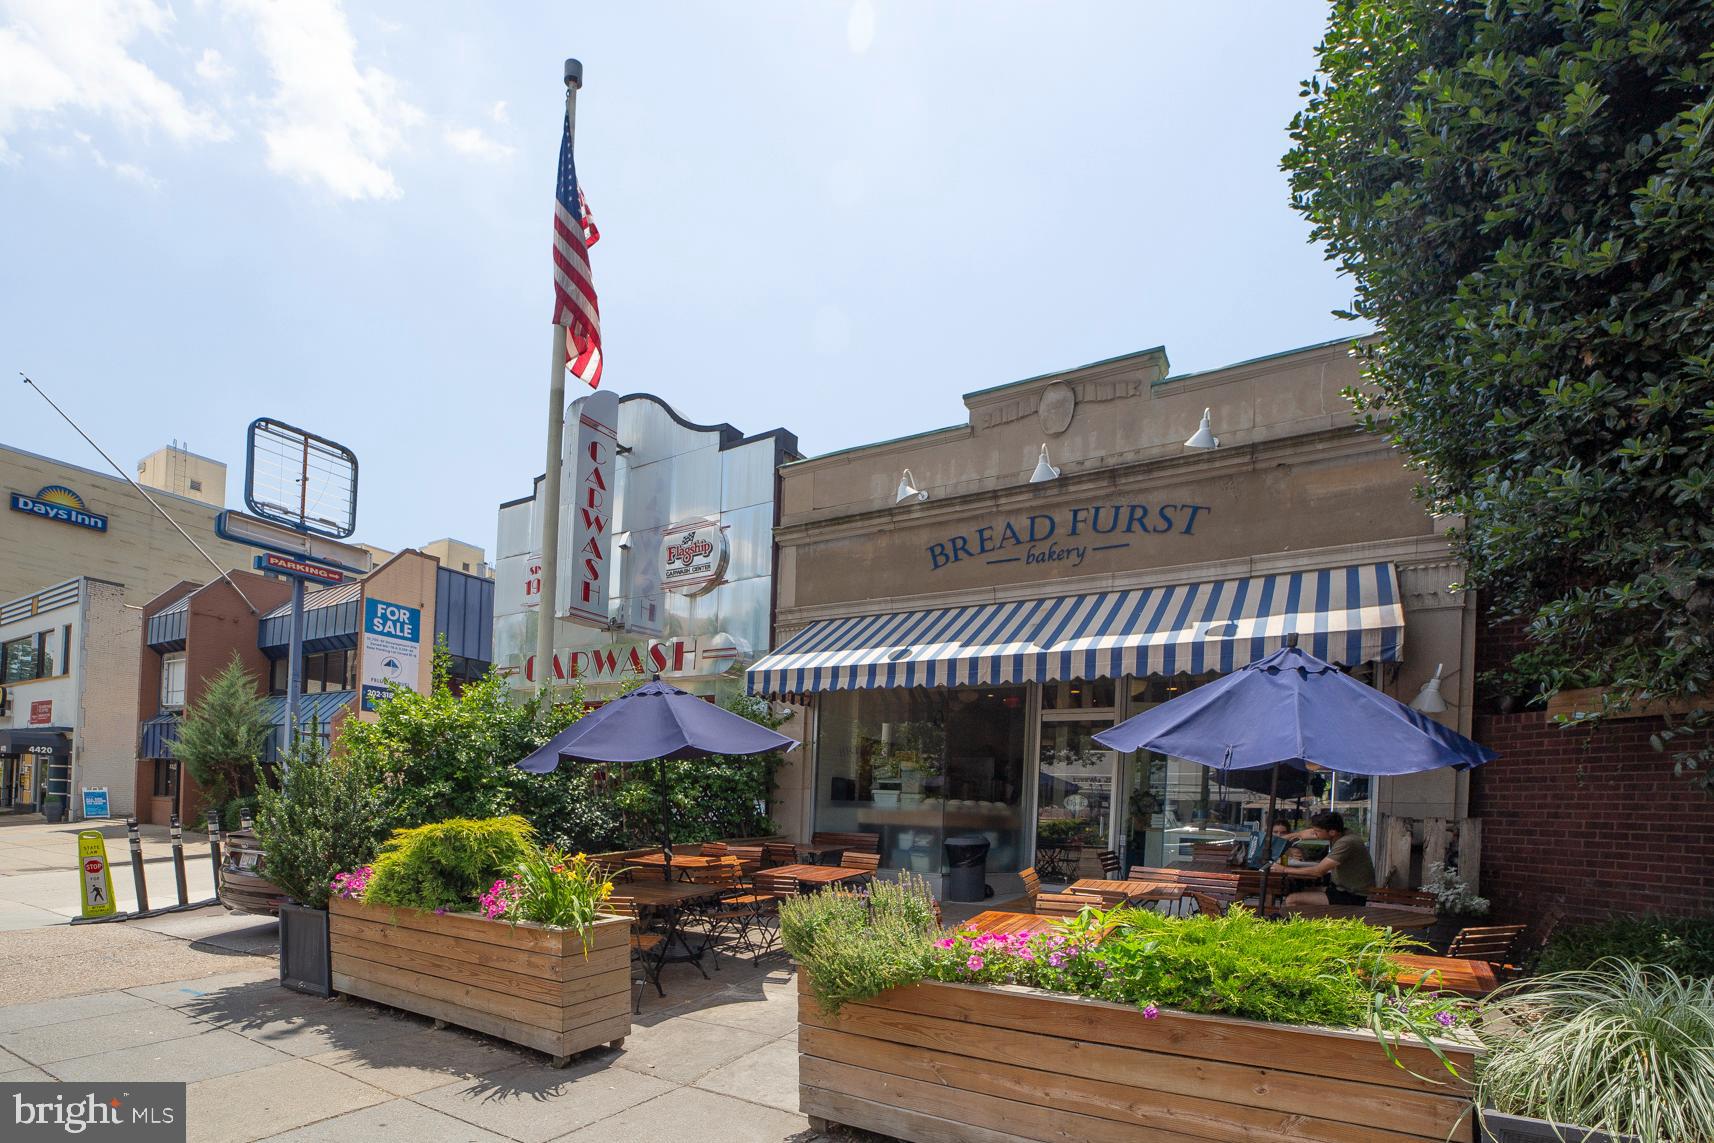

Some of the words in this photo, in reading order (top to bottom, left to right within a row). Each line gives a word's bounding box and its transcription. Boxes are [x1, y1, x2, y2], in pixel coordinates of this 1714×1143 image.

[18, 497, 68, 519] Days
[71, 511, 102, 528] Inn
[580, 440, 608, 603] CARWASH
[926, 514, 1056, 571] BREAD
[1066, 504, 1212, 536] FURST
[667, 539, 713, 566] Flagship
[1025, 542, 1087, 567] bakery
[269, 557, 328, 577] PARKING
[666, 567, 690, 577] CARWASH
[691, 564, 711, 573] CENTER
[377, 603, 410, 623] FOR
[373, 617, 413, 638] SALE
[29, 746, 53, 754] 4420
[86, 863, 102, 871] STOP
